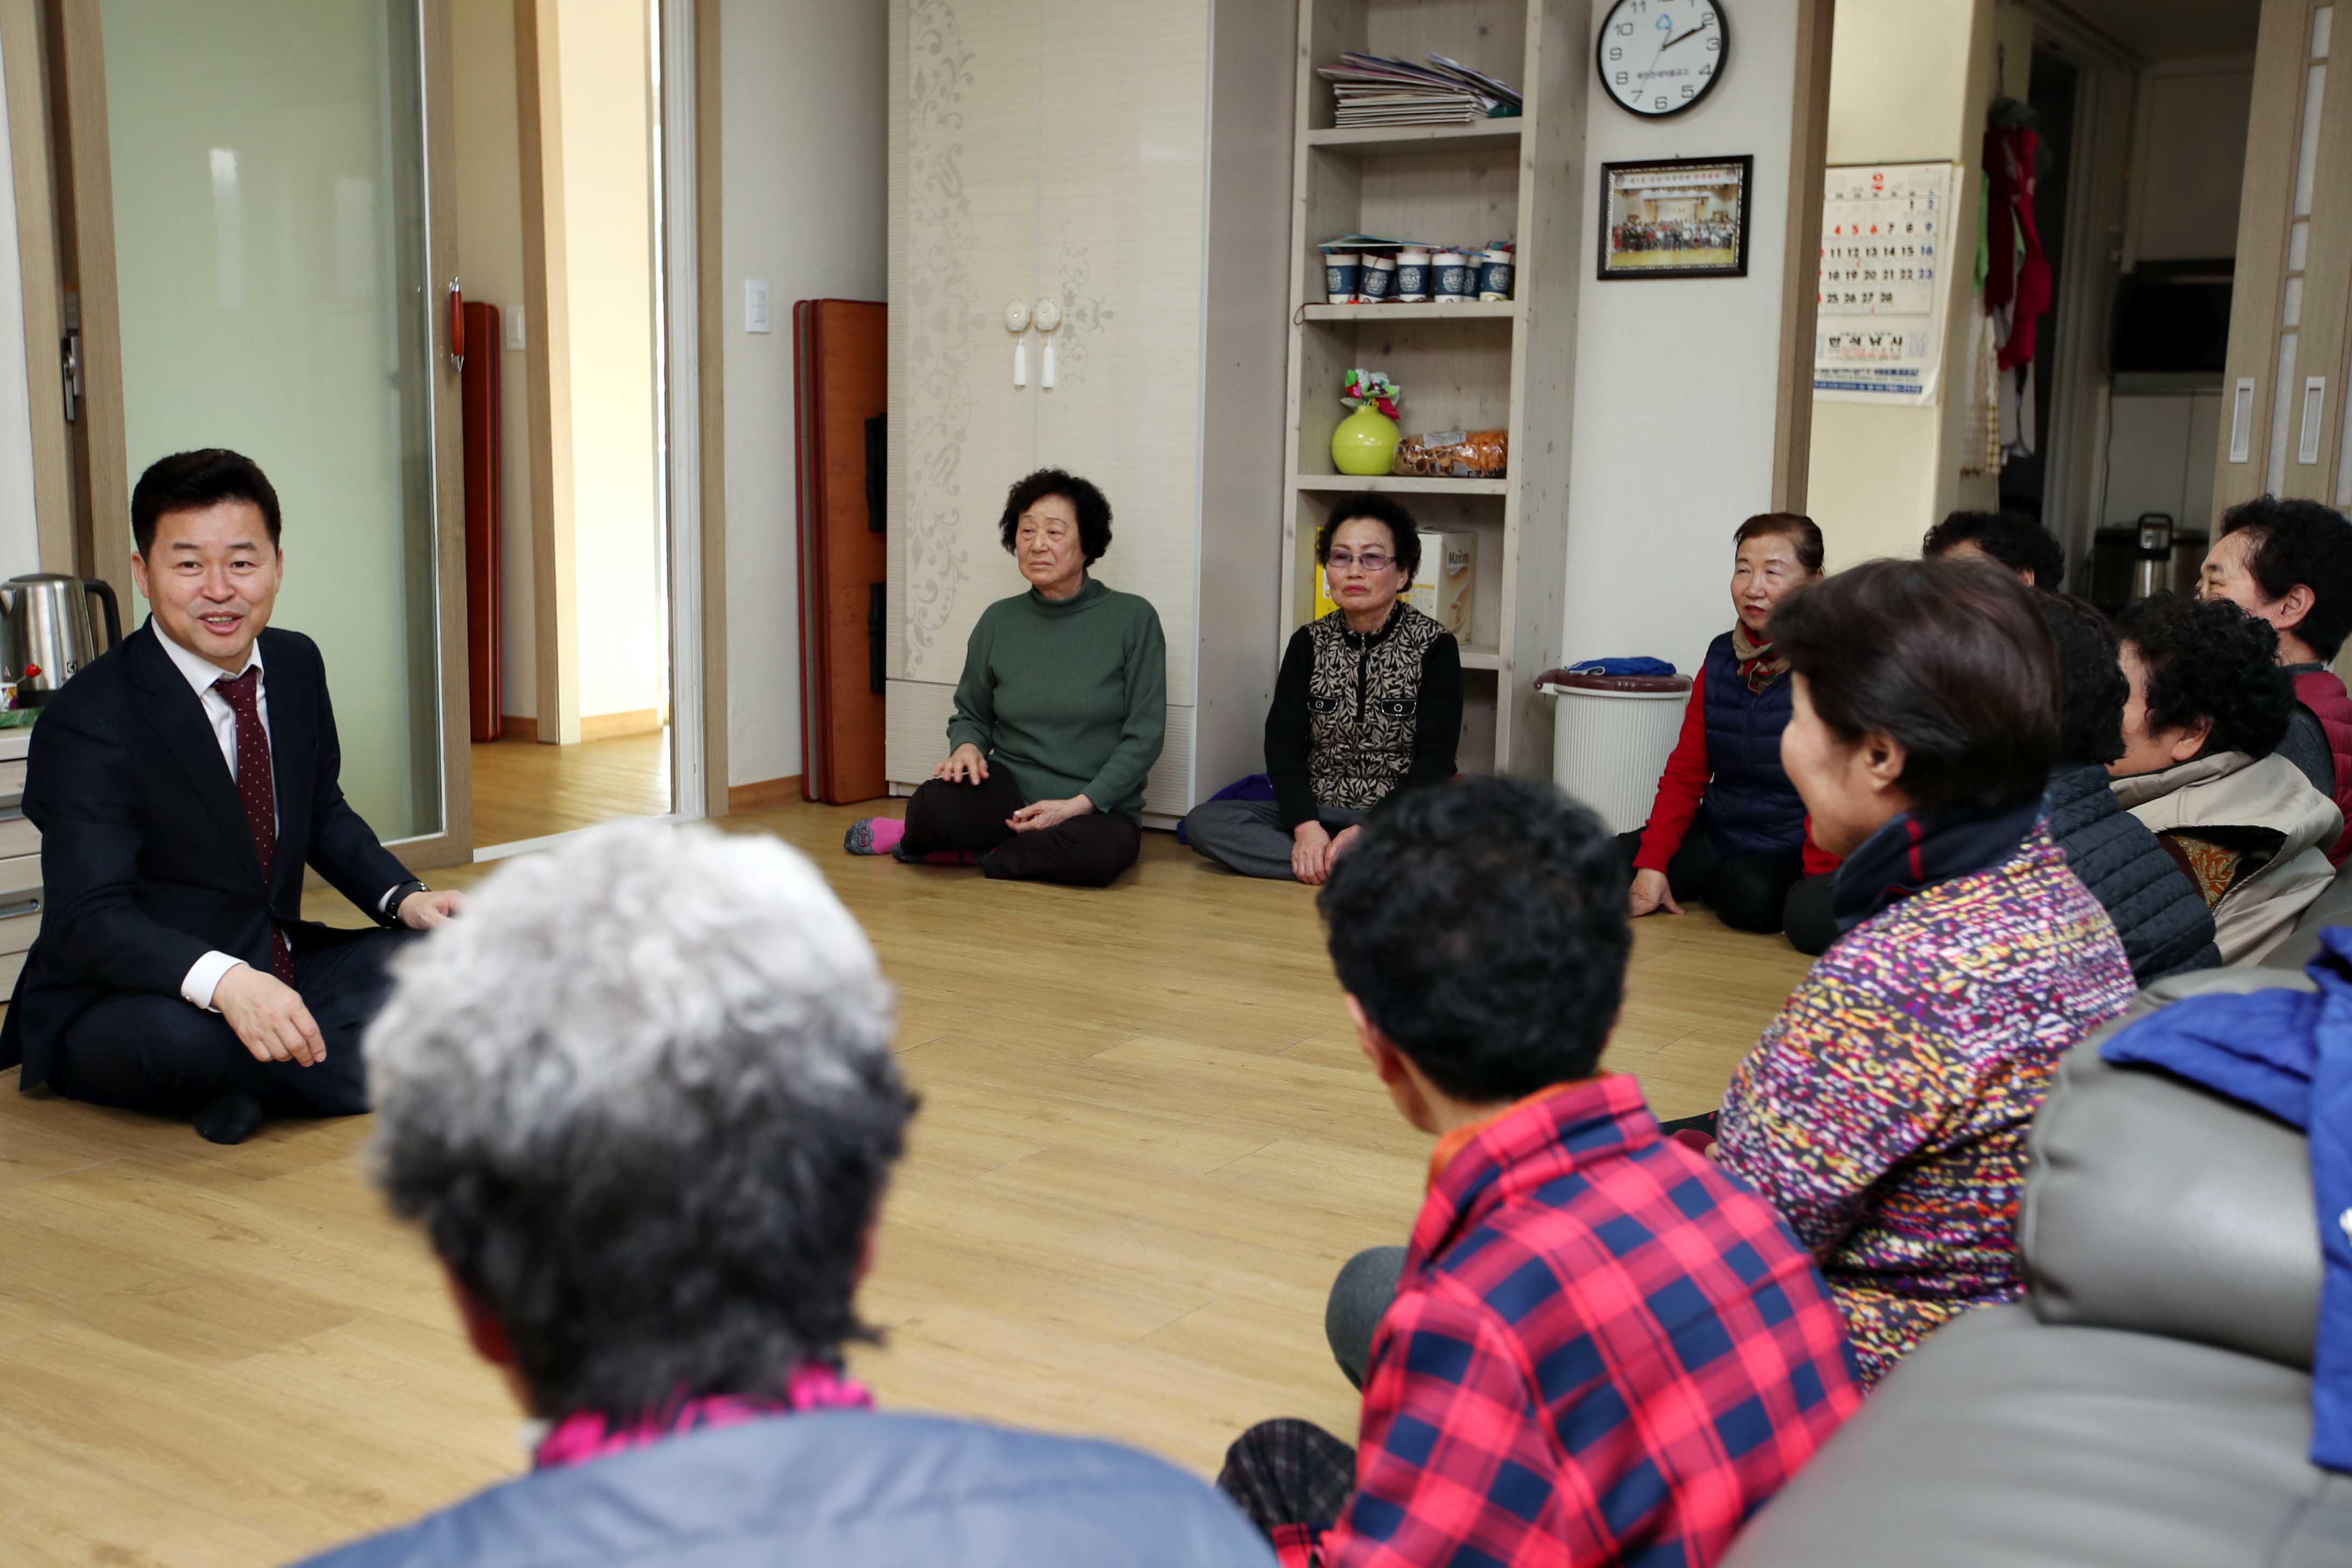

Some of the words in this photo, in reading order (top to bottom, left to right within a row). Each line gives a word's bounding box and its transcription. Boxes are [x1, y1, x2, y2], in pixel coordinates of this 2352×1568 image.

[1630, 1, 1646, 13] 11
[1702, 11, 1715, 26] 2
[1614, 22, 1634, 36] 10
[1706, 37, 1720, 51] 3
[1609, 47, 1622, 61] 9
[1698, 64, 1713, 76] 4
[1615, 71, 1629, 86] 8
[1630, 89, 1644, 104] 7
[1681, 84, 1695, 99] 5
[1654, 96, 1668, 110] 6
[1872, 172, 1885, 191] 2
[1834, 224, 1842, 235] 4
[1852, 223, 1859, 235] 5
[1870, 224, 1878, 235] 6
[1888, 223, 1895, 234] 7
[1830, 248, 1842, 258] 11
[1847, 248, 1859, 258] 12
[1865, 247, 1878, 257] 13
[1884, 247, 1895, 256] 14
[1901, 246, 1914, 256] 15
[1921, 246, 1933, 256] 16
[1828, 271, 1840, 281] 18
[1846, 270, 1858, 280] 19
[1864, 270, 1877, 281] 20
[1882, 269, 1894, 280] 21
[1900, 269, 1913, 280] 22
[1919, 269, 1933, 279] 23
[1827, 292, 1839, 303] 25
[1845, 293, 1856, 303] 26
[1862, 292, 1874, 303] 27
[1448, 551, 1469, 565] Maxim
